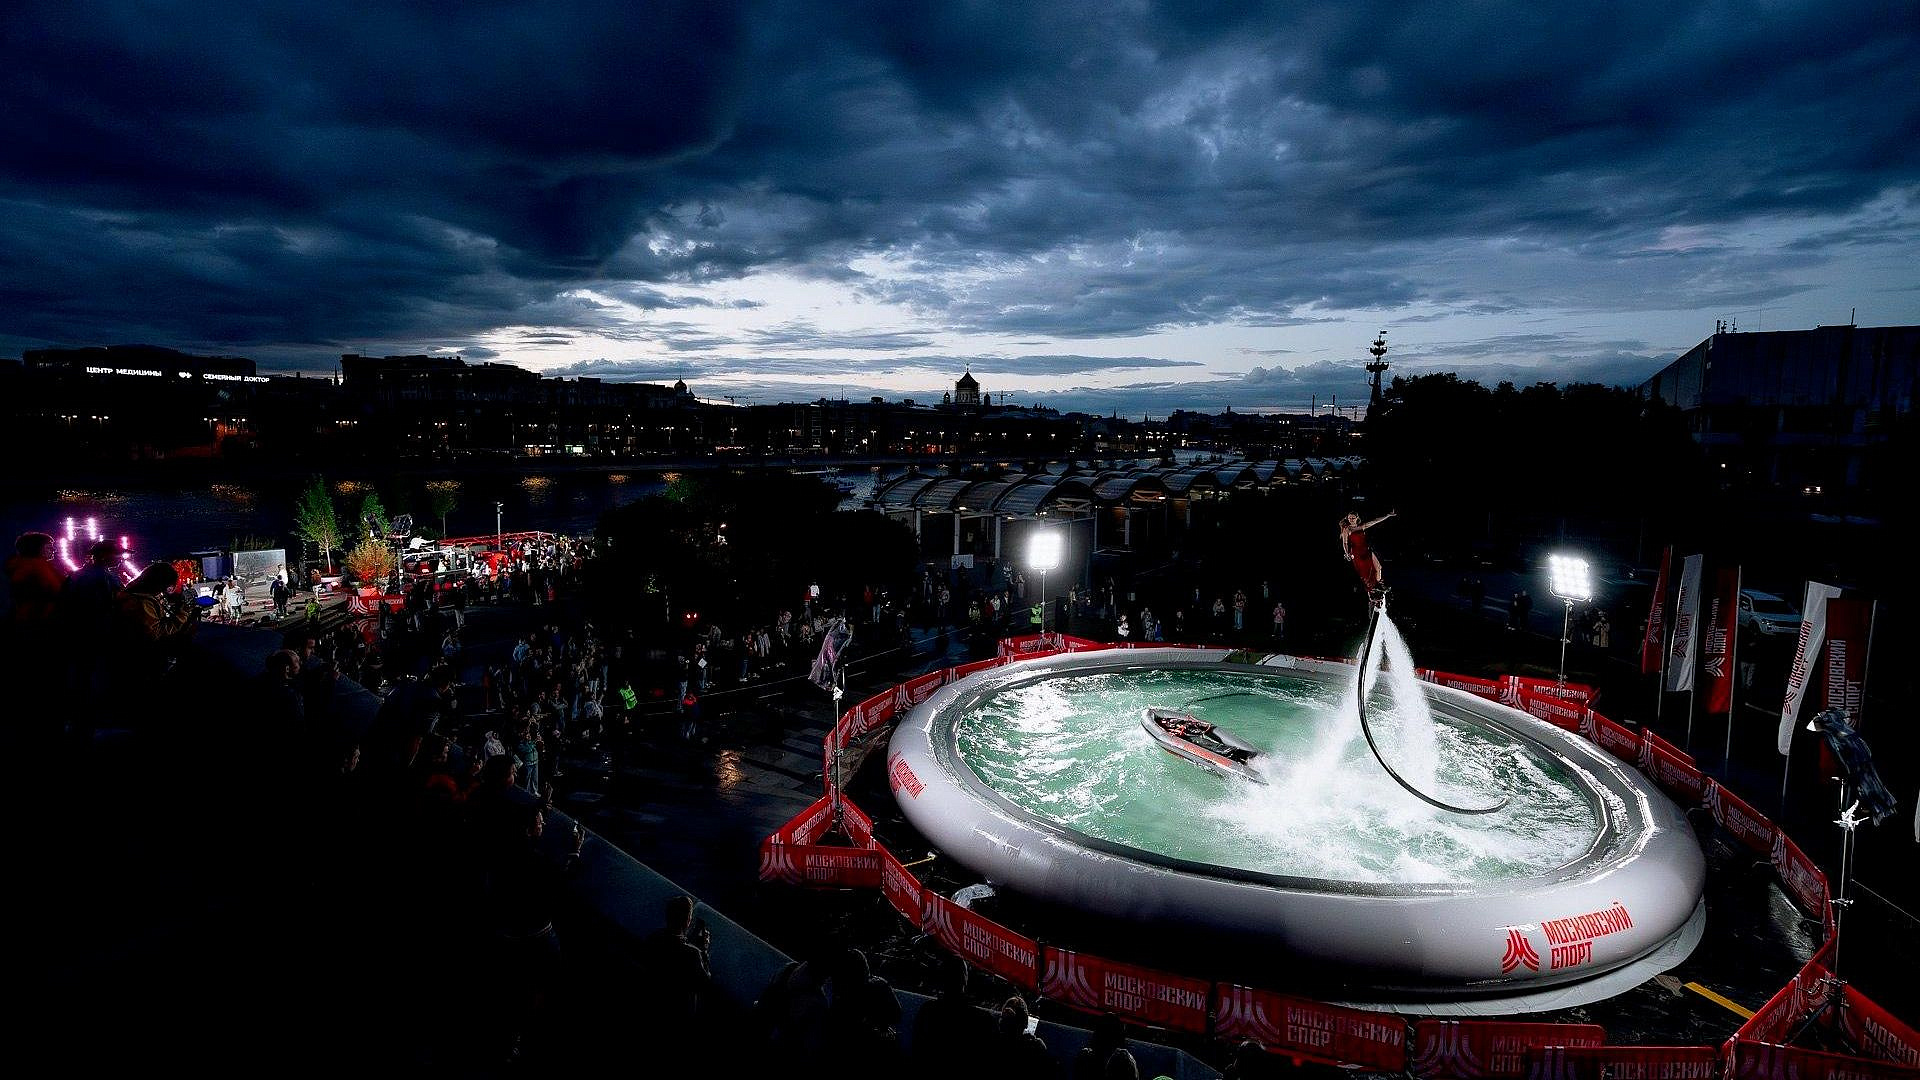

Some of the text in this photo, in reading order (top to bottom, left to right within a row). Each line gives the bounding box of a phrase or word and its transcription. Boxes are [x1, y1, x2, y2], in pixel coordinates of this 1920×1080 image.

[86, 366, 162, 377] ЦЕНТР МЕДИЦИНЫ
[1712, 627, 1728, 655] СПОРТ
[1446, 679, 1497, 696] МОСКОВСКИЙ
[1533, 685, 1588, 700] МОСКОВСКИЙ
[1530, 698, 1580, 720] МОСКОВСКИЙ
[805, 853, 881, 871] МОСКОВСКИЙ
[806, 866, 839, 881] СПОРТ
[1541, 902, 1633, 945] МОСКОВСКИЙ
[962, 919, 1036, 970] МОСКОВСКИЙ
[1551, 941, 1593, 970] СПОРТ
[1104, 970, 1207, 1013] МОСКОВСКИЙ
[1104, 988, 1150, 1014] СПОРТ
[1287, 1006, 1402, 1048] МОСКОВСКИЙ
[1287, 1024, 1339, 1048] СПОР
